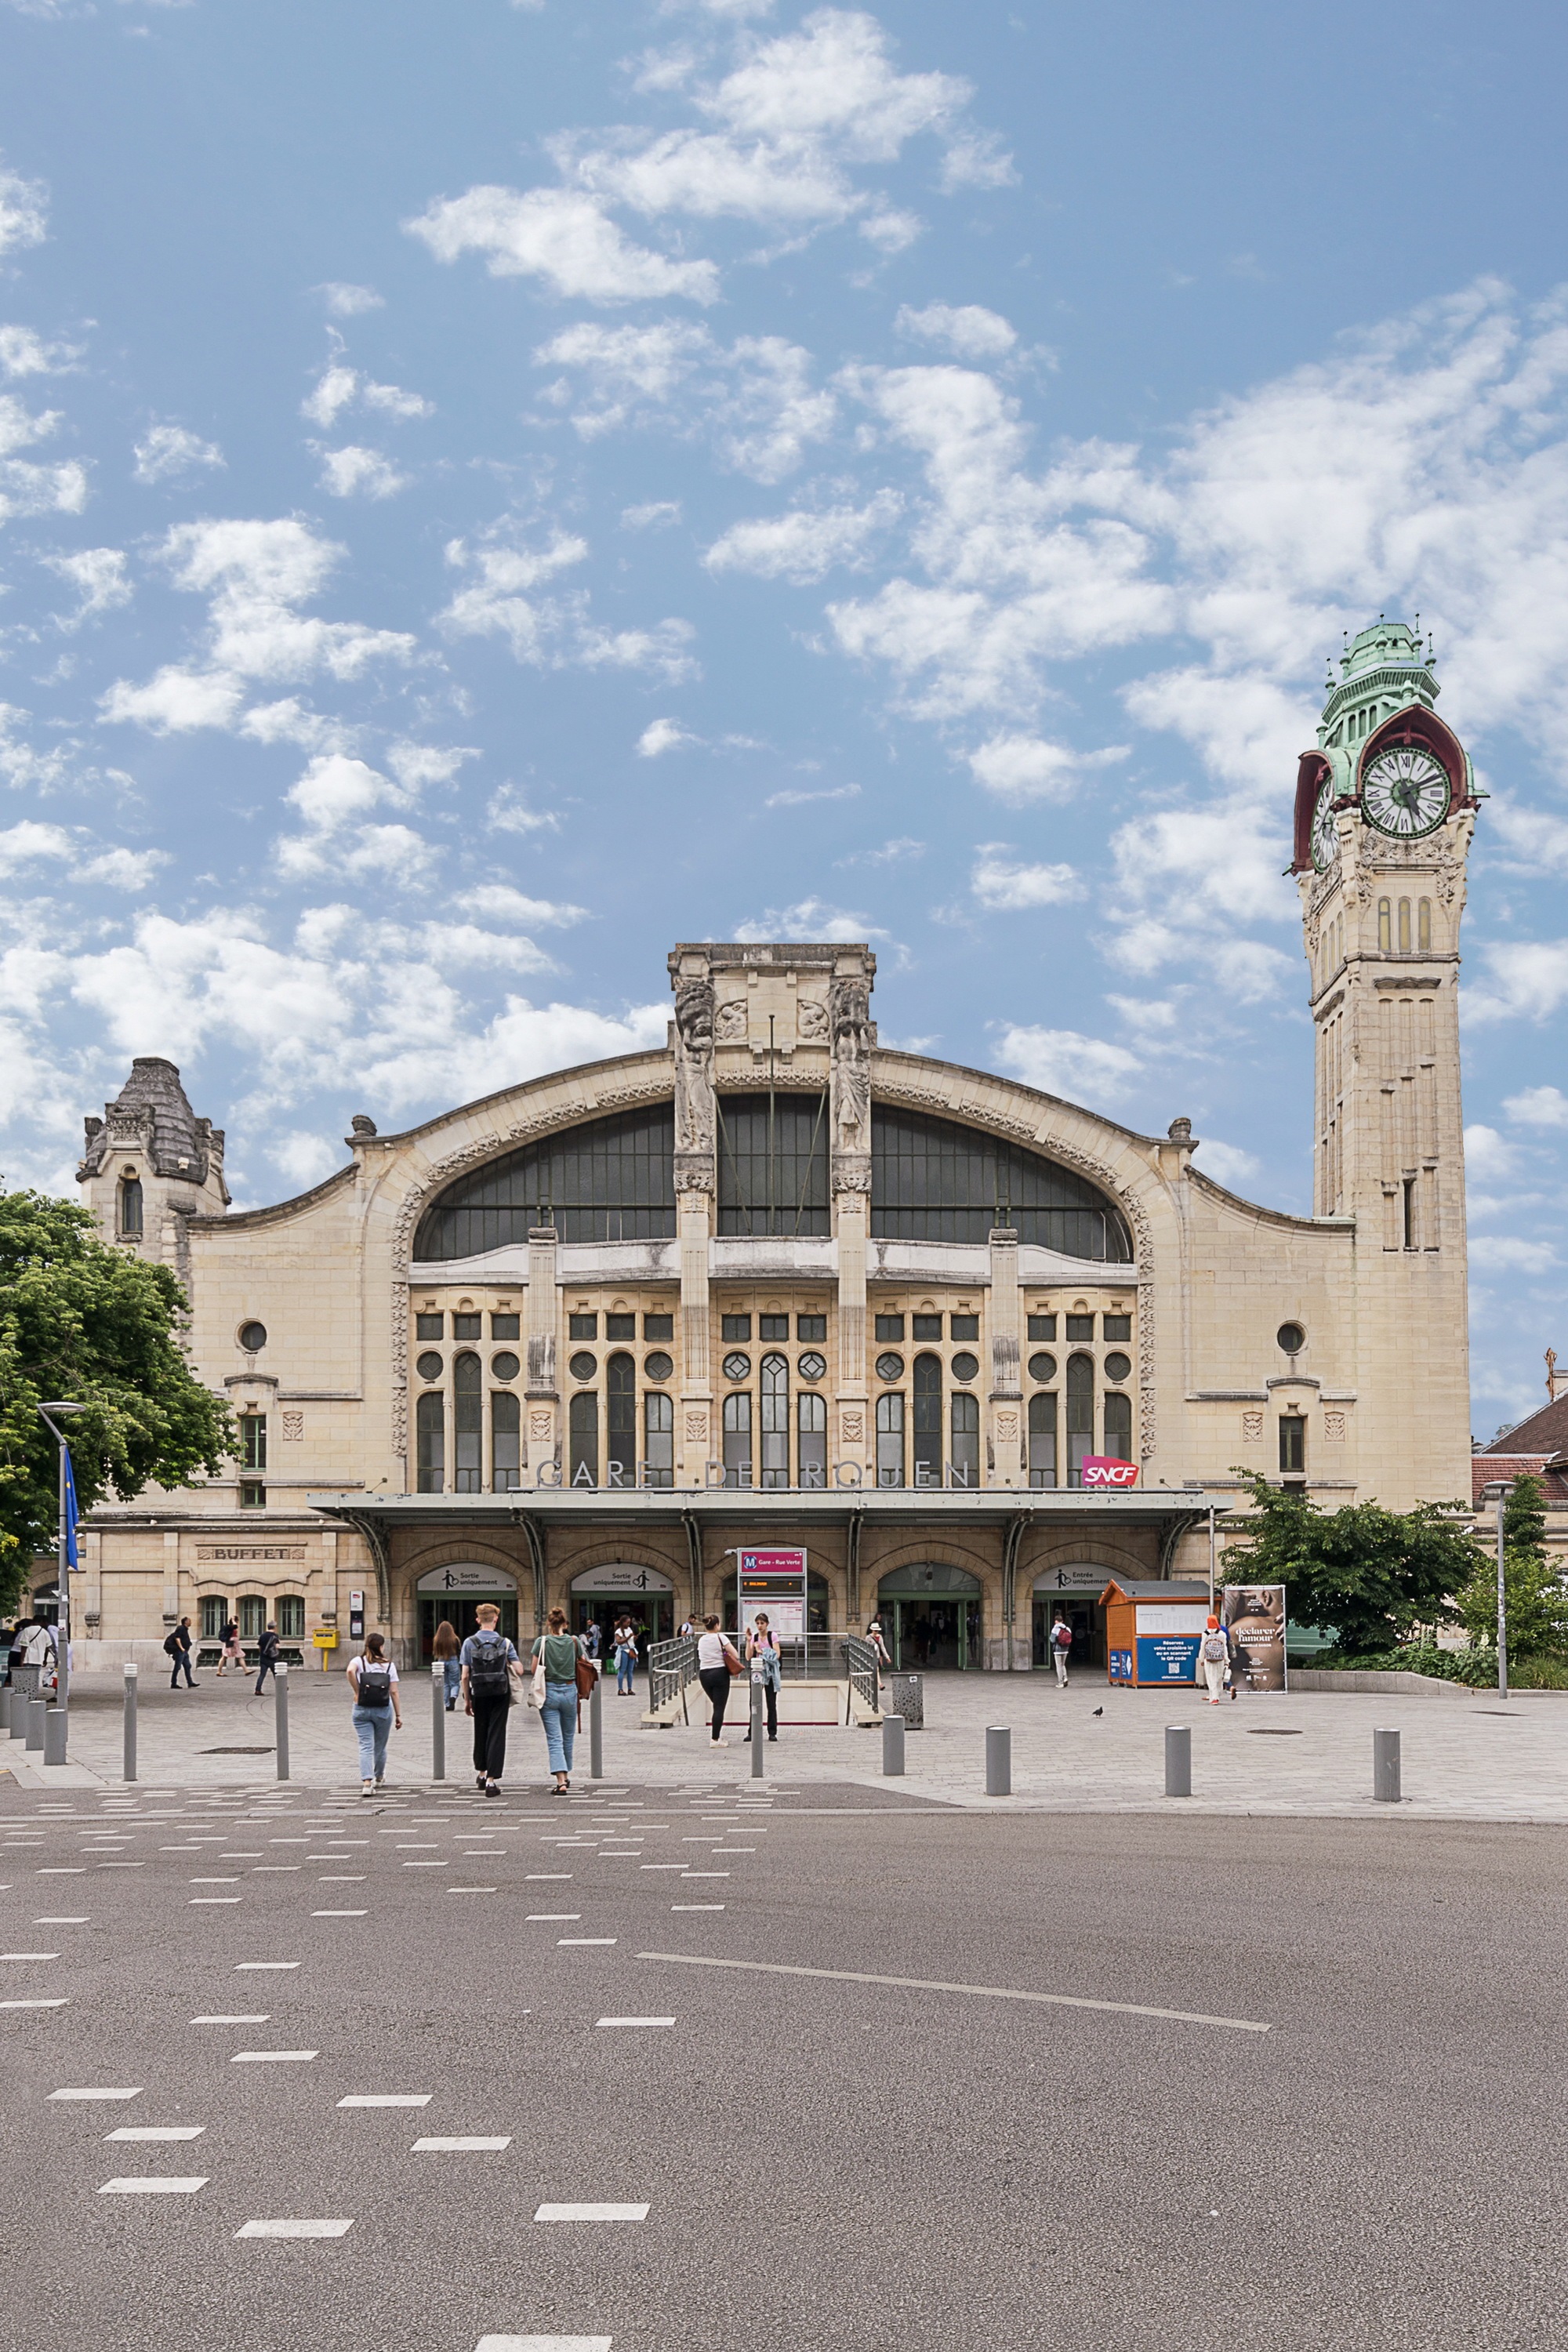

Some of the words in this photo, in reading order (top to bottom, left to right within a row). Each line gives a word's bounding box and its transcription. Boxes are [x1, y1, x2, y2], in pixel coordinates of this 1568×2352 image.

[536, 1460, 652, 1487] GARE
[705, 1461, 753, 1487] DE
[804, 1460, 968, 1488] ROUEN
[1084, 1466, 1136, 1483] SNCF
[214, 1548, 288, 1560] BUFFET
[1235, 1627, 1276, 1635] déclarer
